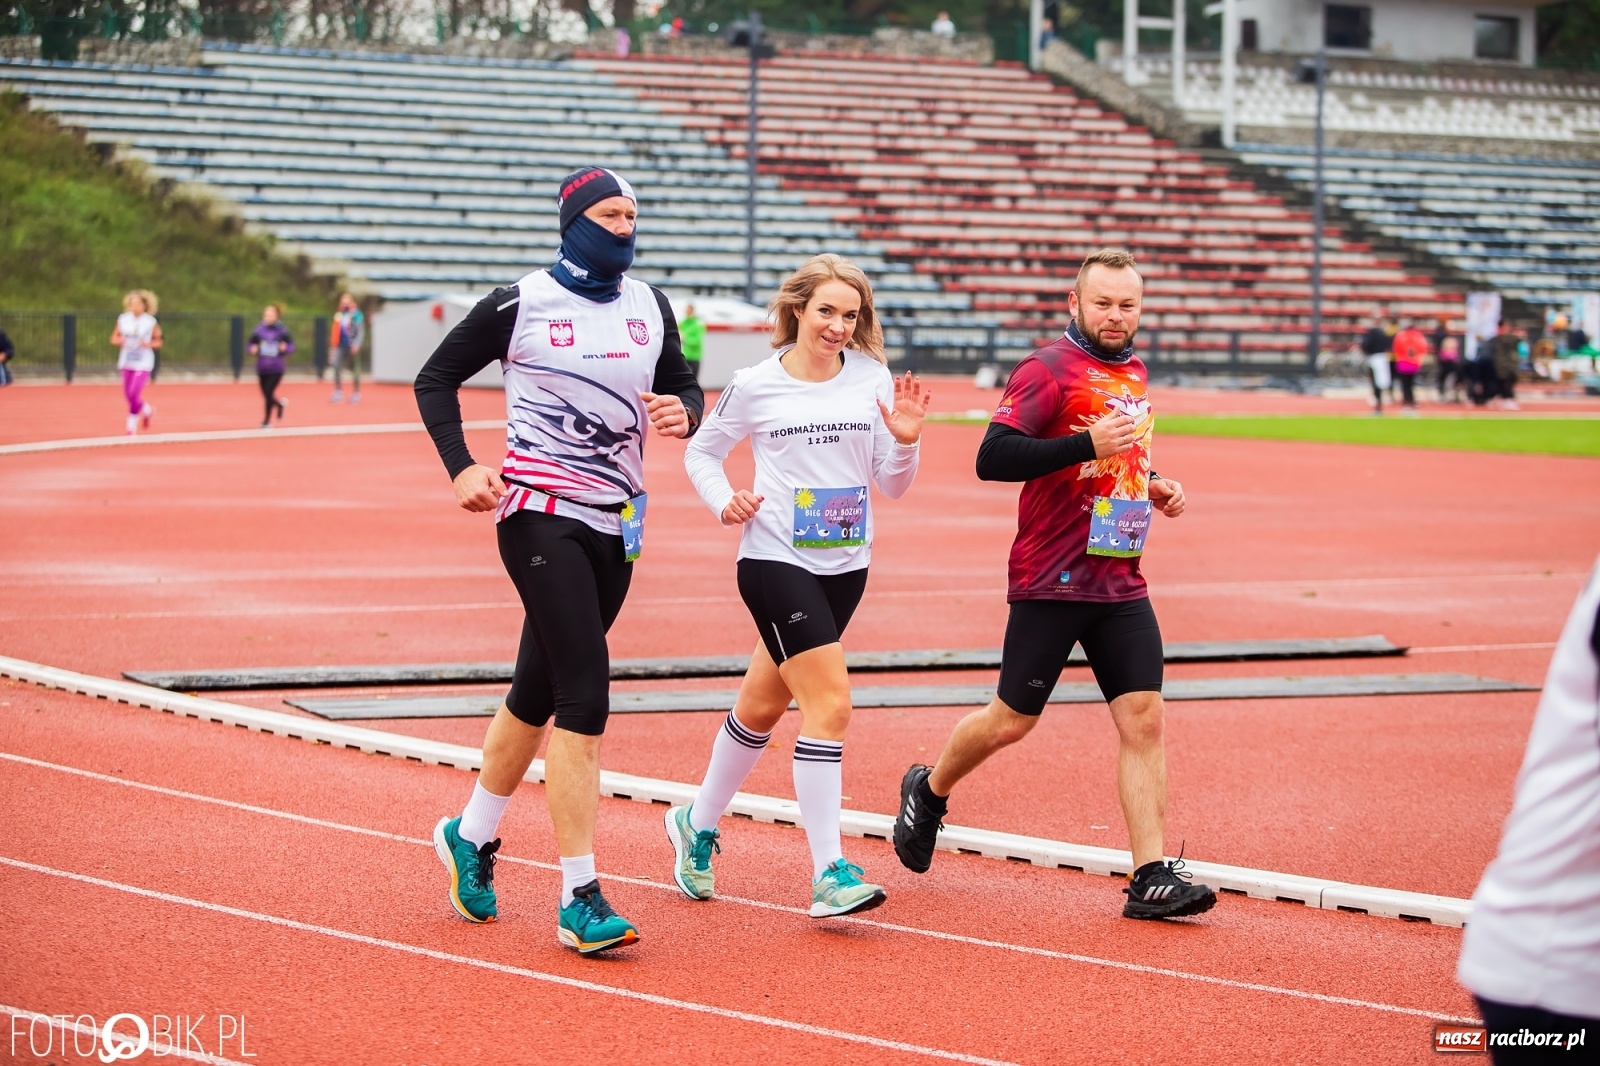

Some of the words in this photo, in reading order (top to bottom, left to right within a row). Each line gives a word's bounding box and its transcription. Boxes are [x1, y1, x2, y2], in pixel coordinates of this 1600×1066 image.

[808, 437, 814, 445] 1
[822, 435, 840, 444] 250
[805, 509, 821, 517] BIEG
[824, 509, 837, 517] DLA
[1101, 518, 1116, 527] BIEG
[841, 527, 860, 539] 012
